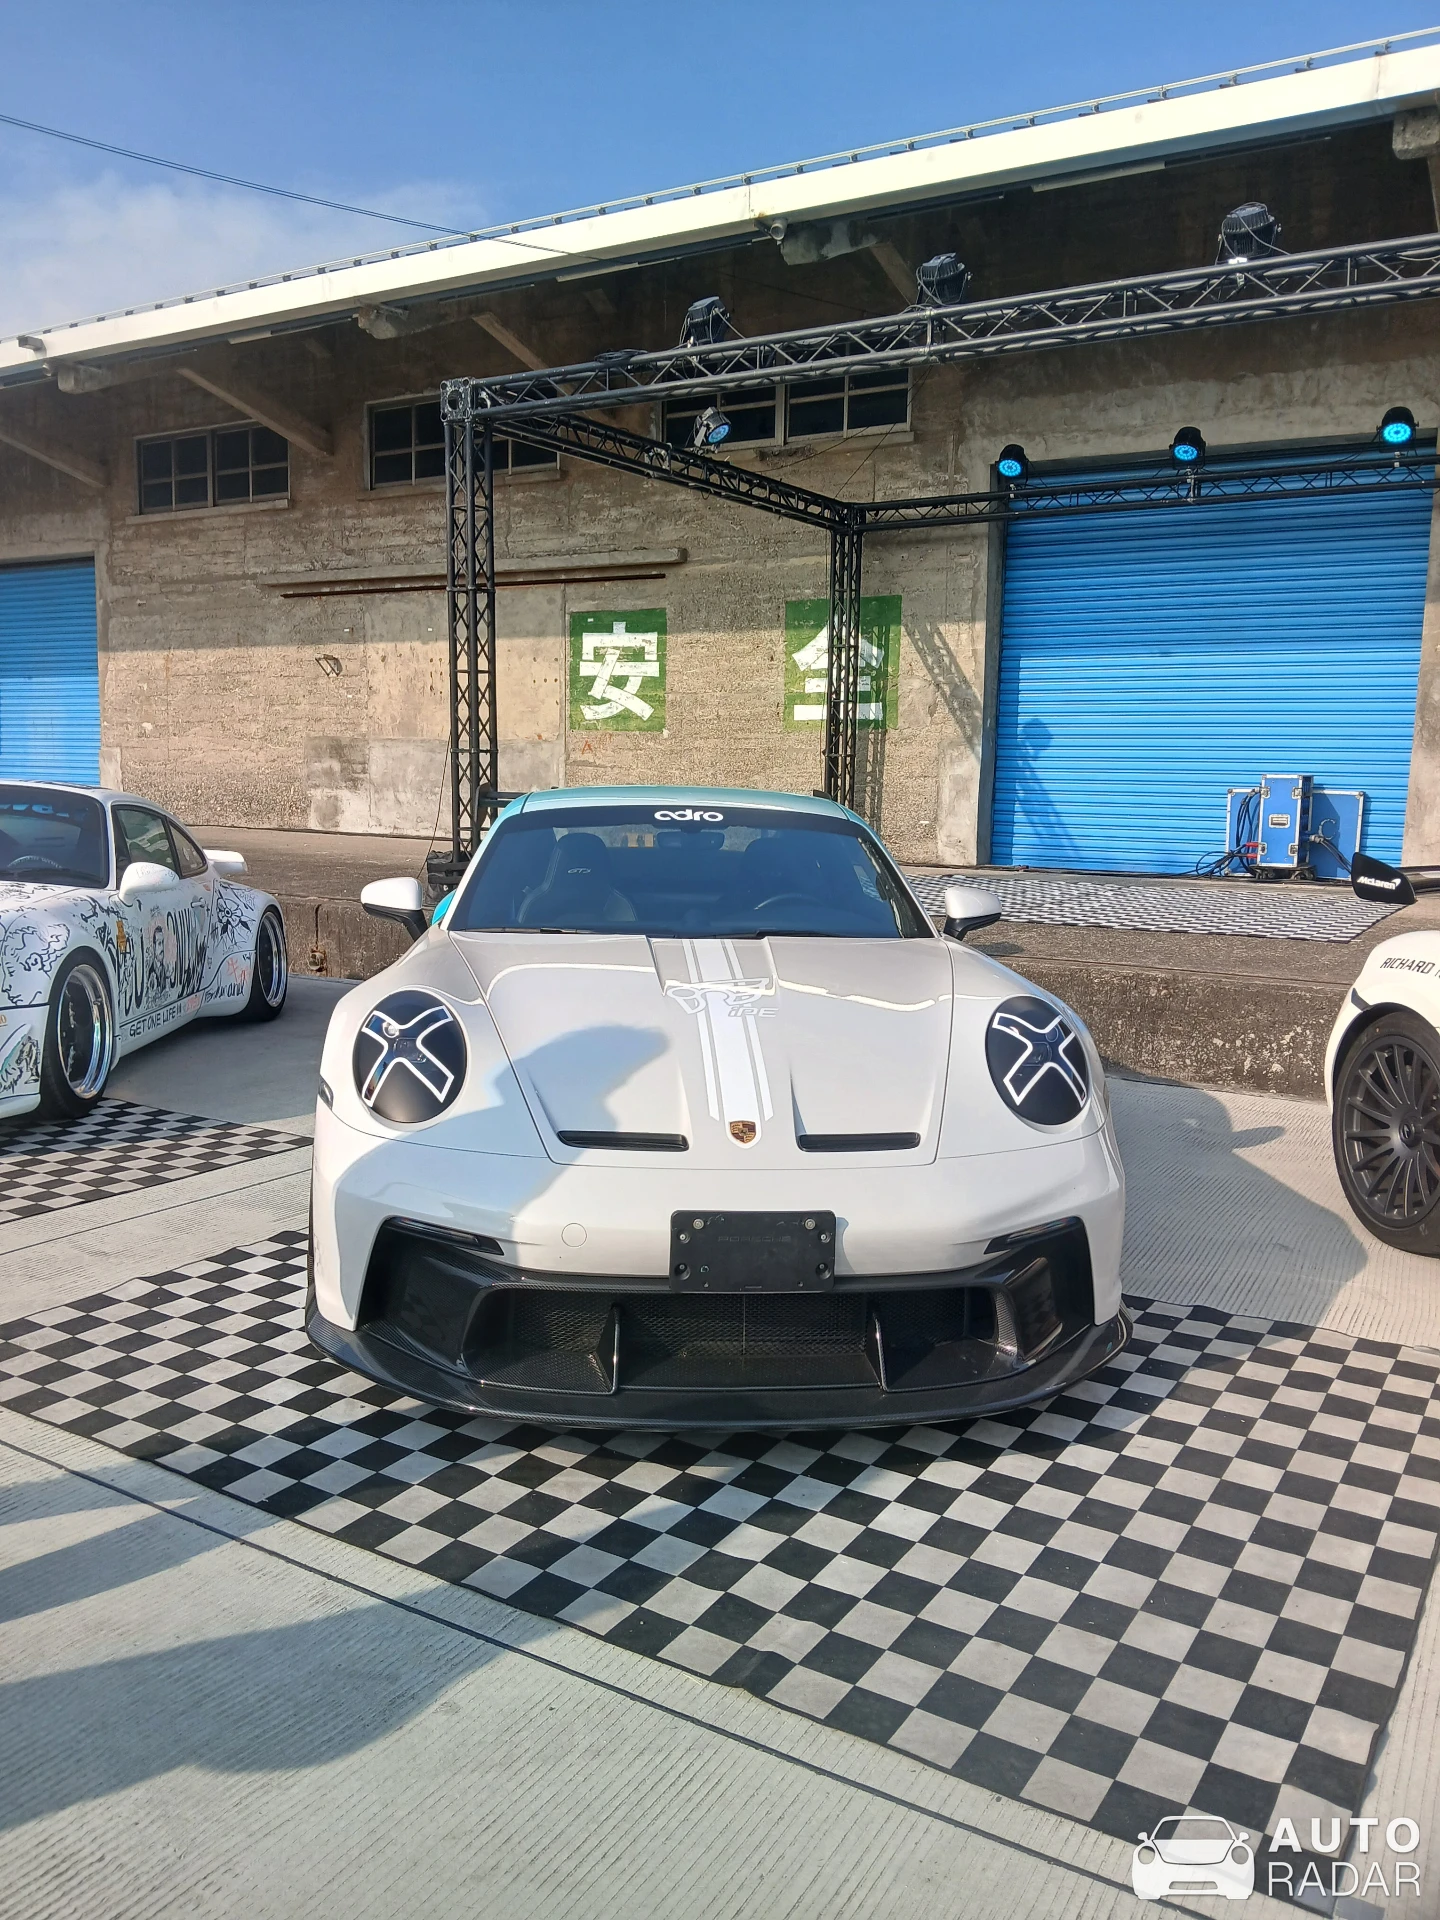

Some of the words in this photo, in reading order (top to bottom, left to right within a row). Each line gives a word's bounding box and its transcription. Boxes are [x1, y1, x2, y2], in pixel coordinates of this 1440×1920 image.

[579, 620, 660, 721] 安
[653, 808, 724, 822] adro
[1357, 876, 1396, 890] McLaren
[1380, 957, 1435, 974] RICHARD
[129, 1018, 147, 1038] GET
[147, 1012, 161, 1031] ONE
